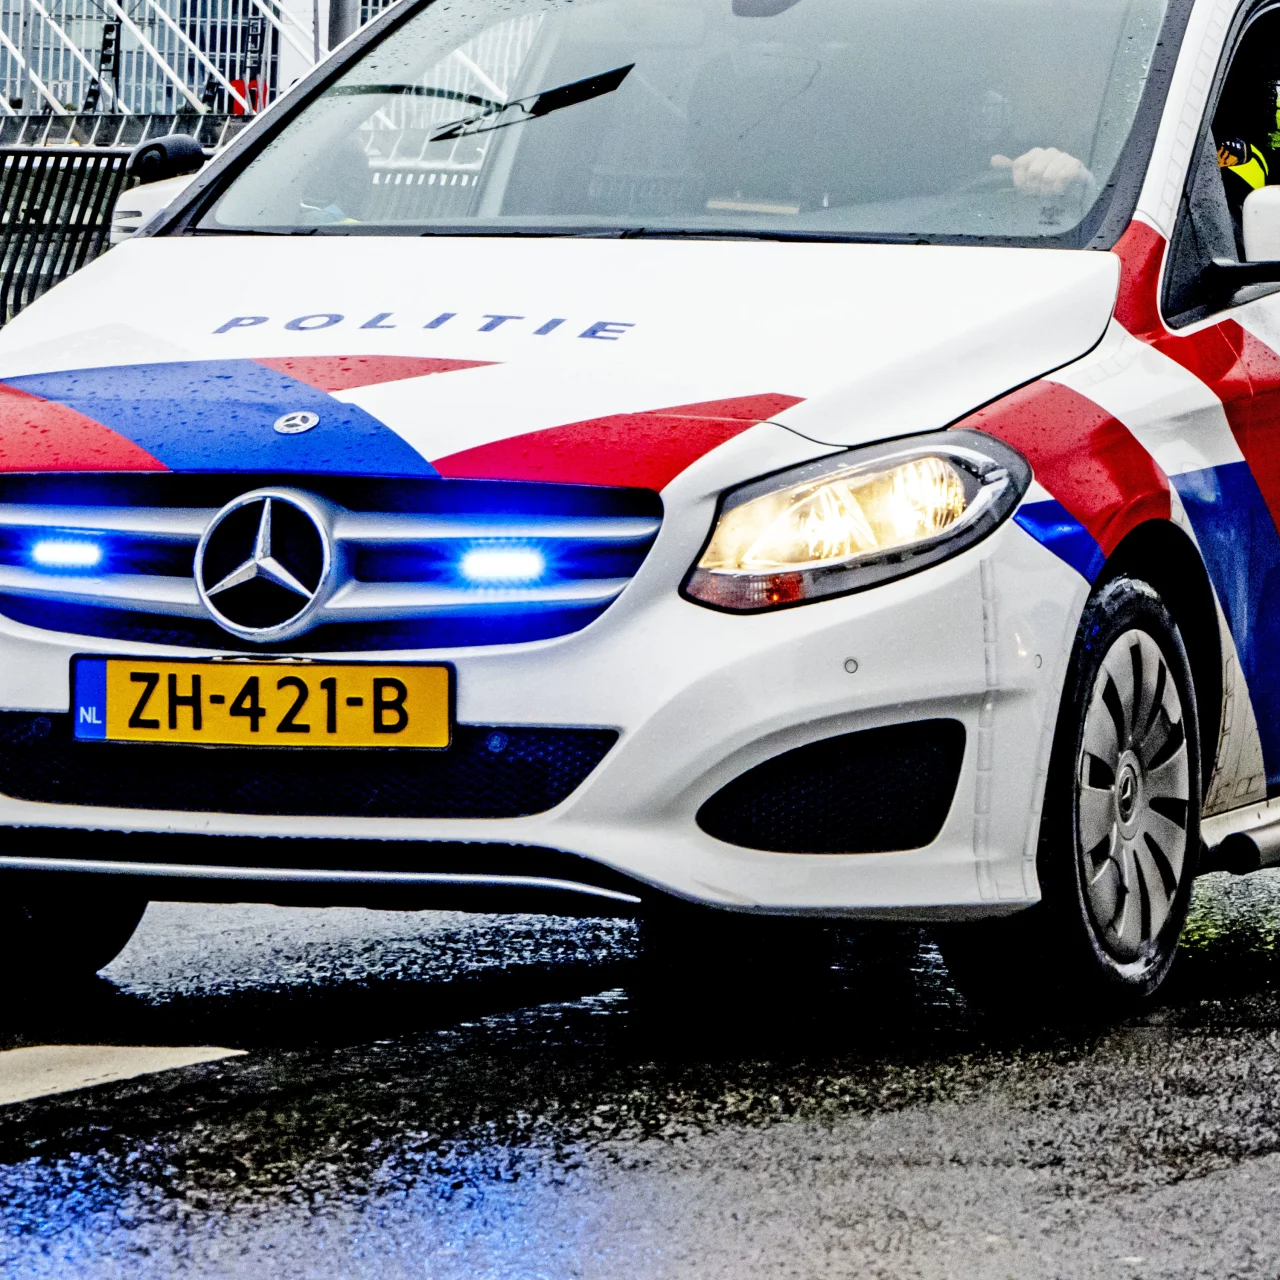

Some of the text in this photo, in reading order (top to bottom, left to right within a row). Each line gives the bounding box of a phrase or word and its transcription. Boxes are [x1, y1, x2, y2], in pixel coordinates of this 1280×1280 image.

[210, 312, 637, 340] POLITIE
[79, 671, 409, 734] NL ZH-421-B
